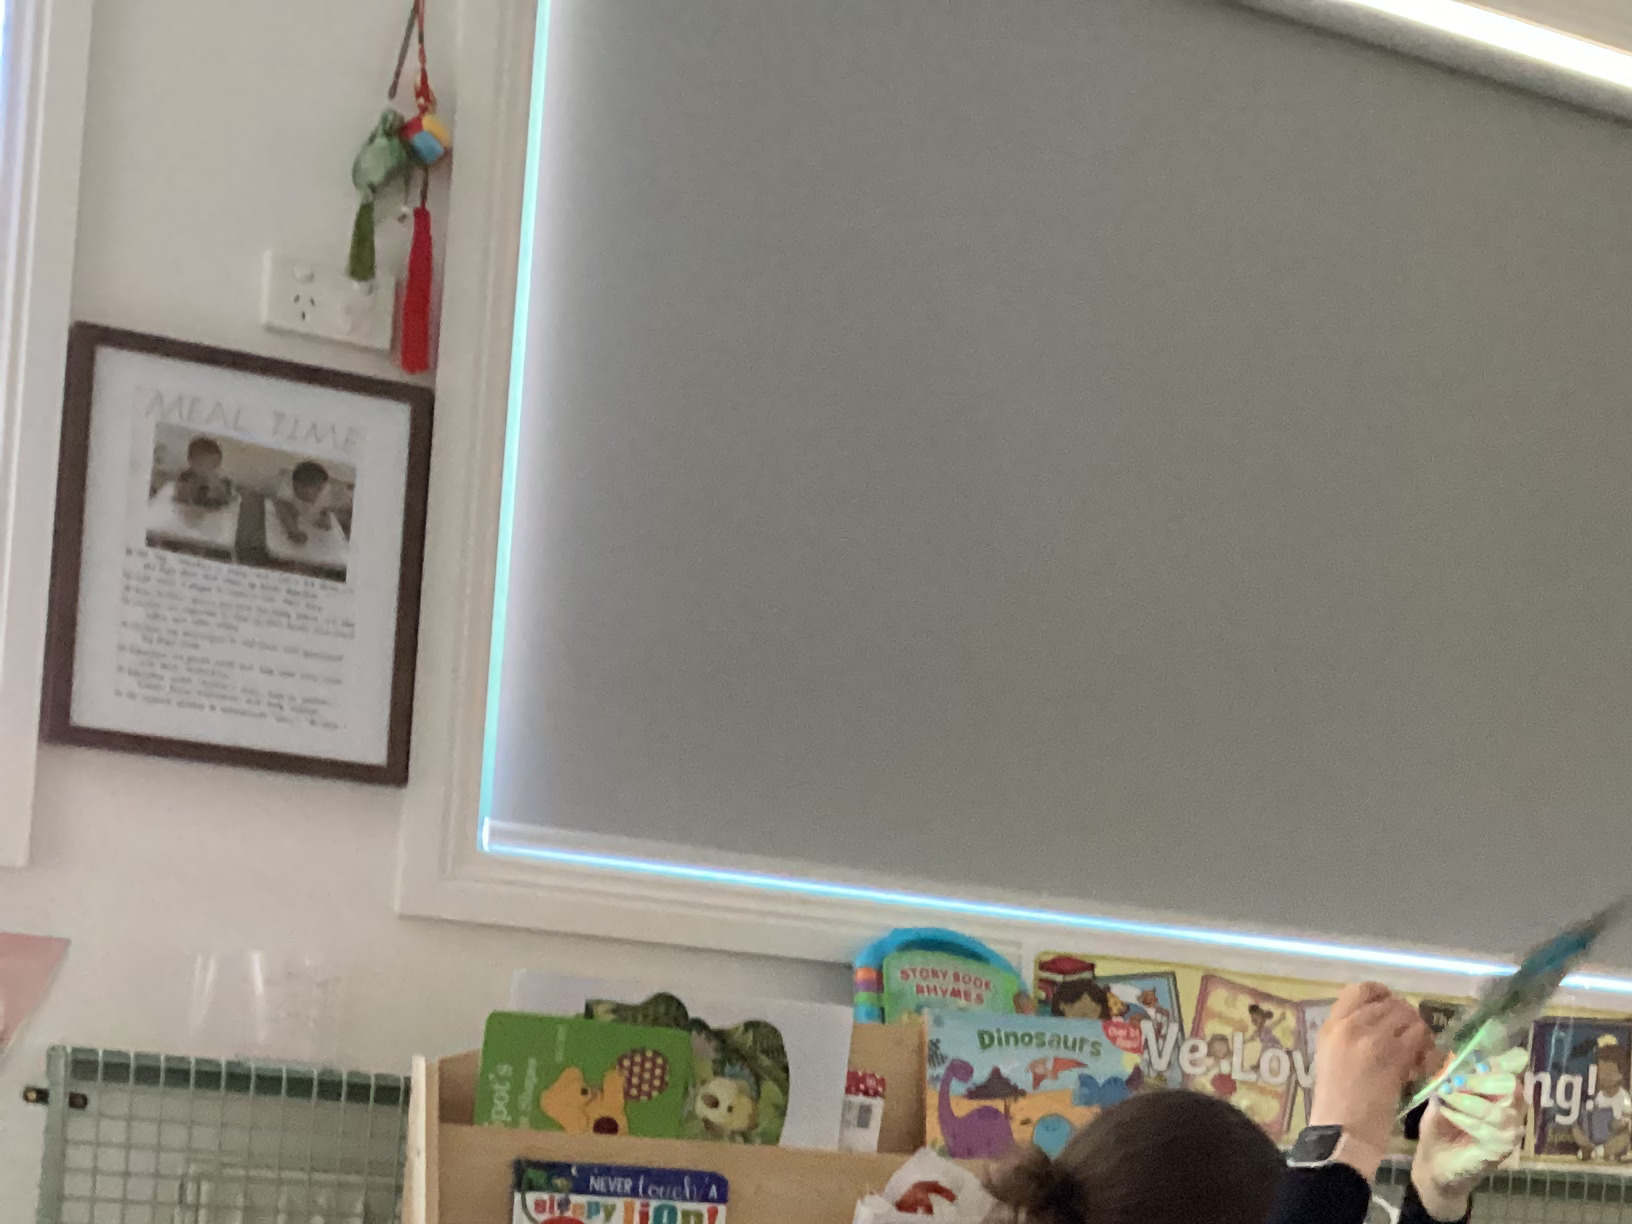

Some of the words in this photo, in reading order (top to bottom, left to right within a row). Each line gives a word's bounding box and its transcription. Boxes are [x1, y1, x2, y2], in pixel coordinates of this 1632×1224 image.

[146, 390, 243, 431] MEAL
[271, 408, 362, 451] TIME
[900, 966, 948, 982] STORY
[952, 970, 992, 991] BOOK
[915, 983, 985, 1005] RHYMES
[976, 1027, 1102, 1057] Dinosaurs
[589, 1175, 633, 1194] NEVER
[638, 1174, 698, 1201] touch
[708, 1183, 719, 1199] A
